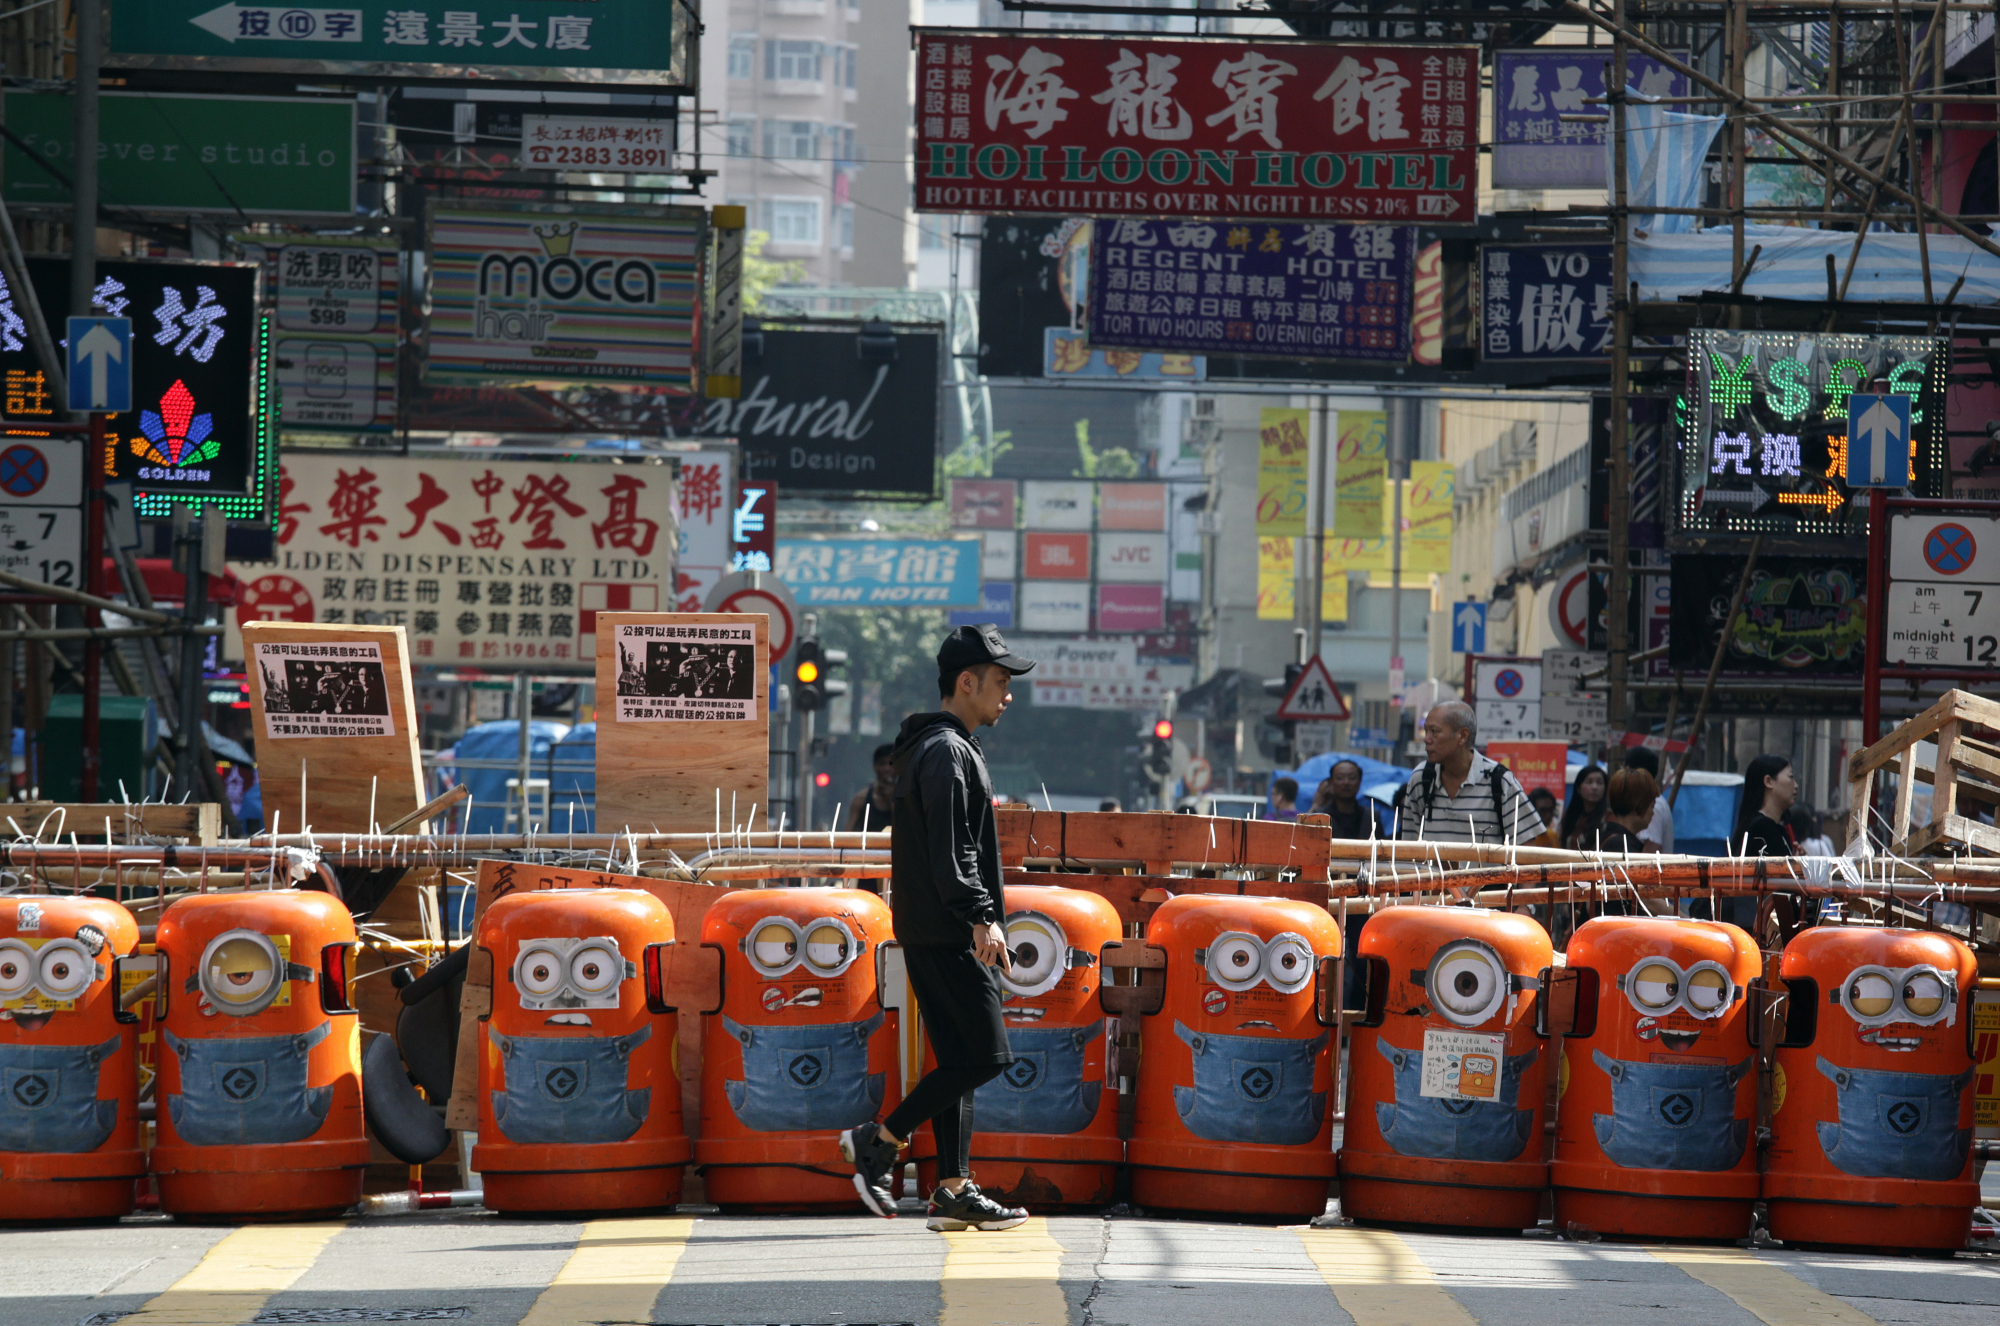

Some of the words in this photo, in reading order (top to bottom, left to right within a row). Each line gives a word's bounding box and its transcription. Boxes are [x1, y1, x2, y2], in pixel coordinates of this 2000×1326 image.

[382, 10, 593, 50] 遠景大廈
[984, 45, 1411, 149] 海龍賓館
[1420, 55, 1443, 148] 全日特平
[1445, 55, 1467, 151] 時租過夜
[22, 134, 180, 163] foever
[200, 143, 336, 167] studio
[556, 146, 610, 164] 2383
[618, 148, 666, 166] 3891
[925, 142, 1049, 181] HOI
[1061, 145, 1239, 186] LOON
[1251, 150, 1466, 191] HOTEL
[924, 186, 1008, 206] HOTEL
[1153, 192, 1219, 211] OVER
[1225, 194, 1303, 213] NIGHT
[1309, 196, 1368, 214] LESS
[1374, 198, 1410, 215] 20%
[286, 251, 373, 280] 洗剪吹
[1106, 247, 1245, 272] REGENT
[1287, 257, 1397, 280] HOTEL
[285, 279, 345, 290] SHAMPOO
[349, 281, 373, 291] CUT
[479, 254, 655, 304] moca
[1107, 267, 1198, 294] 酒店設備
[1204, 273, 1286, 298] 豪華套房
[1301, 278, 1354, 302] 二小時
[1365, 281, 1398, 304] $78
[310, 308, 347, 325] $98
[1104, 292, 1195, 316] 旅遊公幹
[1201, 297, 1242, 318] 日租
[1253, 300, 1340, 324] 特平過夜
[1487, 251, 1511, 354] 專業染色
[476, 300, 554, 341] hair
[1137, 315, 1172, 337] TWO
[1175, 317, 1224, 340] HOURS
[1256, 323, 1343, 346] OVERNIGHT
[790, 446, 876, 473] Design
[137, 466, 211, 482] GOLDEN
[39, 513, 57, 539] 7
[382, 553, 577, 577] DISPENSARY
[591, 558, 660, 580] LTD.
[1111, 546, 1151, 562] JVC
[39, 560, 74, 587] 12
[322, 577, 441, 603] 政府註冊
[455, 579, 575, 607] 專營批發
[870, 586, 950, 601] HOTEL
[1915, 587, 1936, 597] am
[1963, 590, 1983, 616] 7
[1908, 601, 1941, 616] 上午
[623, 626, 752, 640] 公投可以是玩弄民意的工具
[1893, 629, 1956, 644] midnight
[1963, 635, 1998, 661] 12
[261, 644, 378, 658] 公投可以是玩弄民意的工具
[1569, 656, 1581, 669] 4
[1907, 645, 1939, 660] 午夜
[1517, 705, 1527, 720] 7
[1563, 721, 1582, 736] 12
[1517, 759, 1548, 771] Uncle
